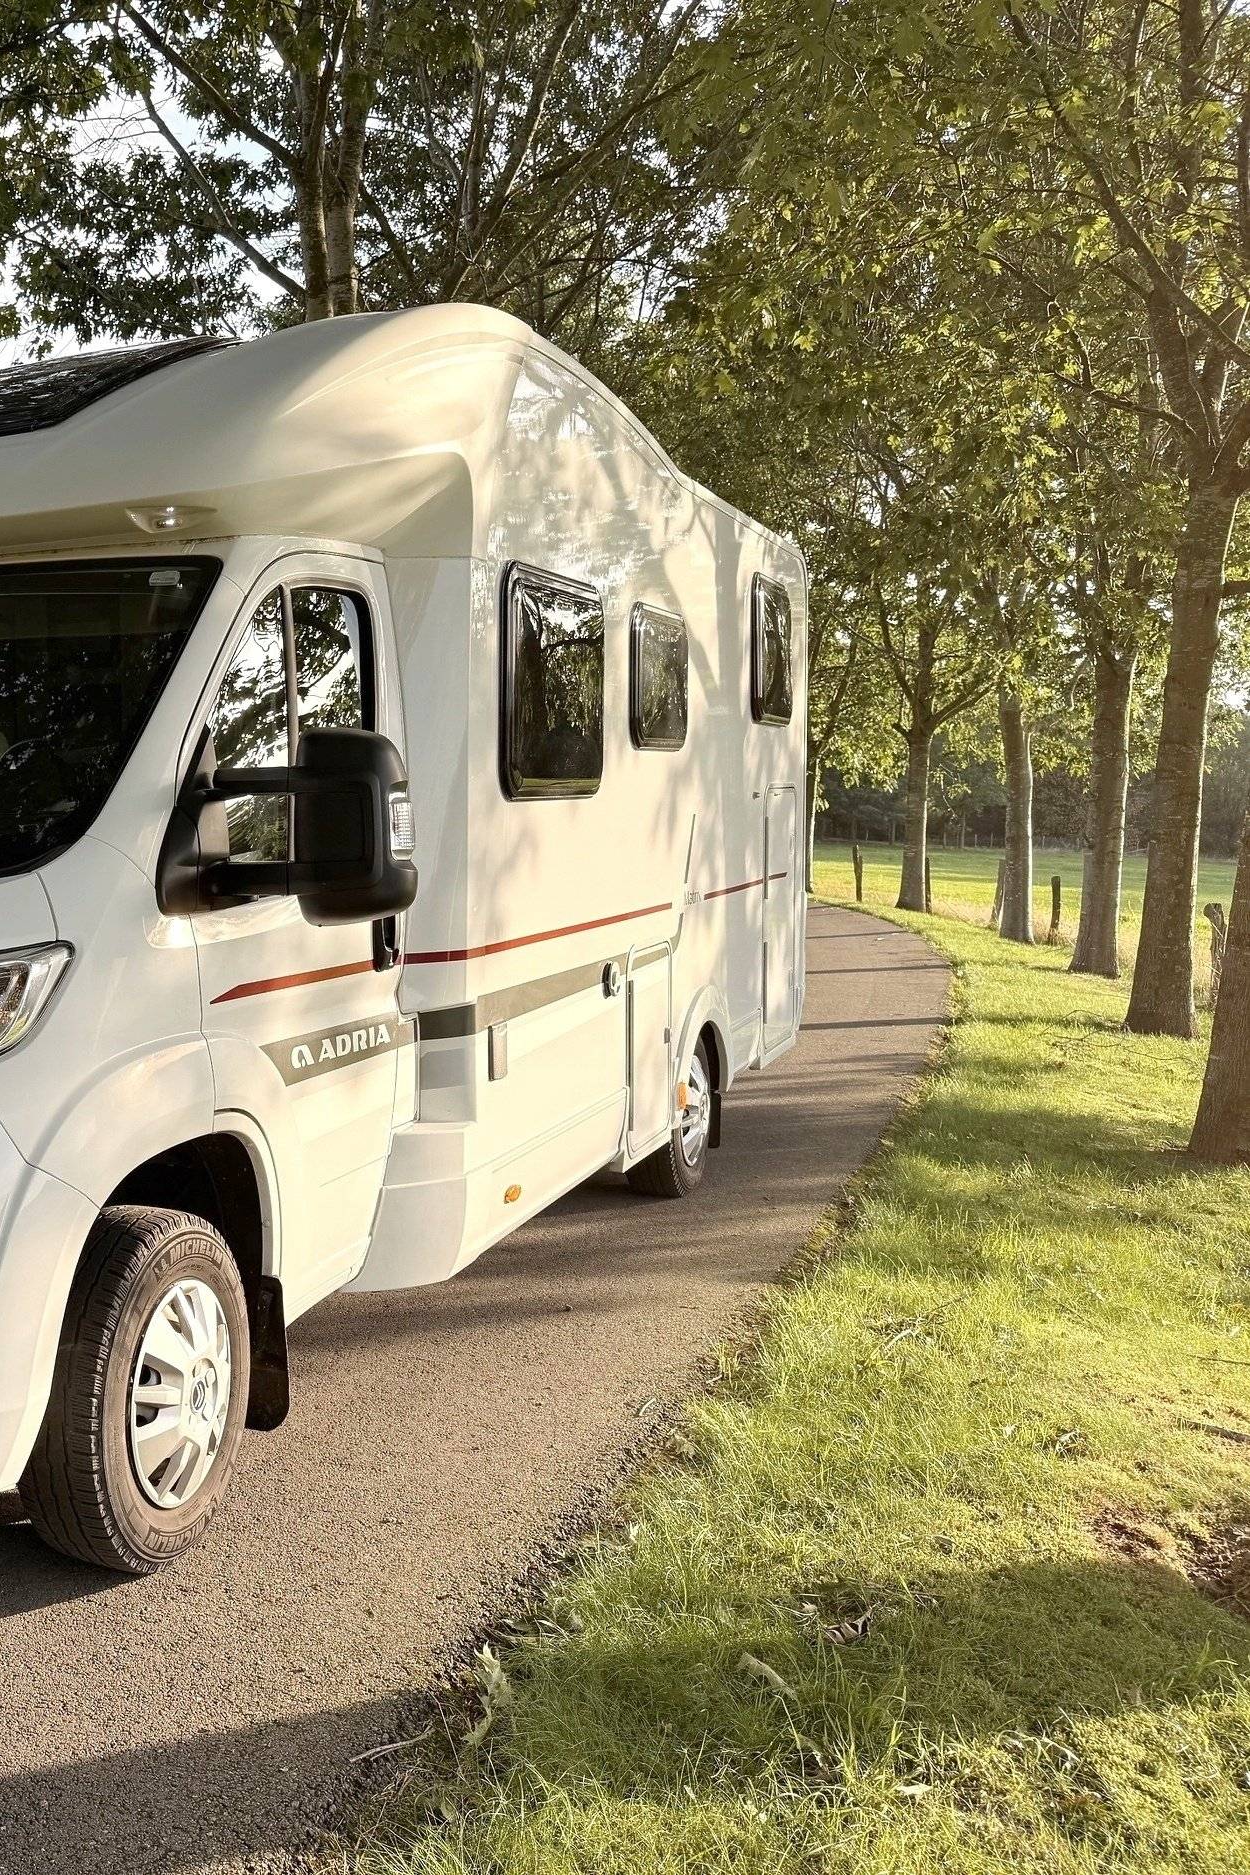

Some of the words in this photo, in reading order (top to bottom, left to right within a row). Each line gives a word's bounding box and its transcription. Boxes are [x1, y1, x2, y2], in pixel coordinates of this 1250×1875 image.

[319, 1024, 391, 1062] ADRIA
[170, 1239, 223, 1265] MICHELIN
[144, 1513, 207, 1553] MICHELIN
